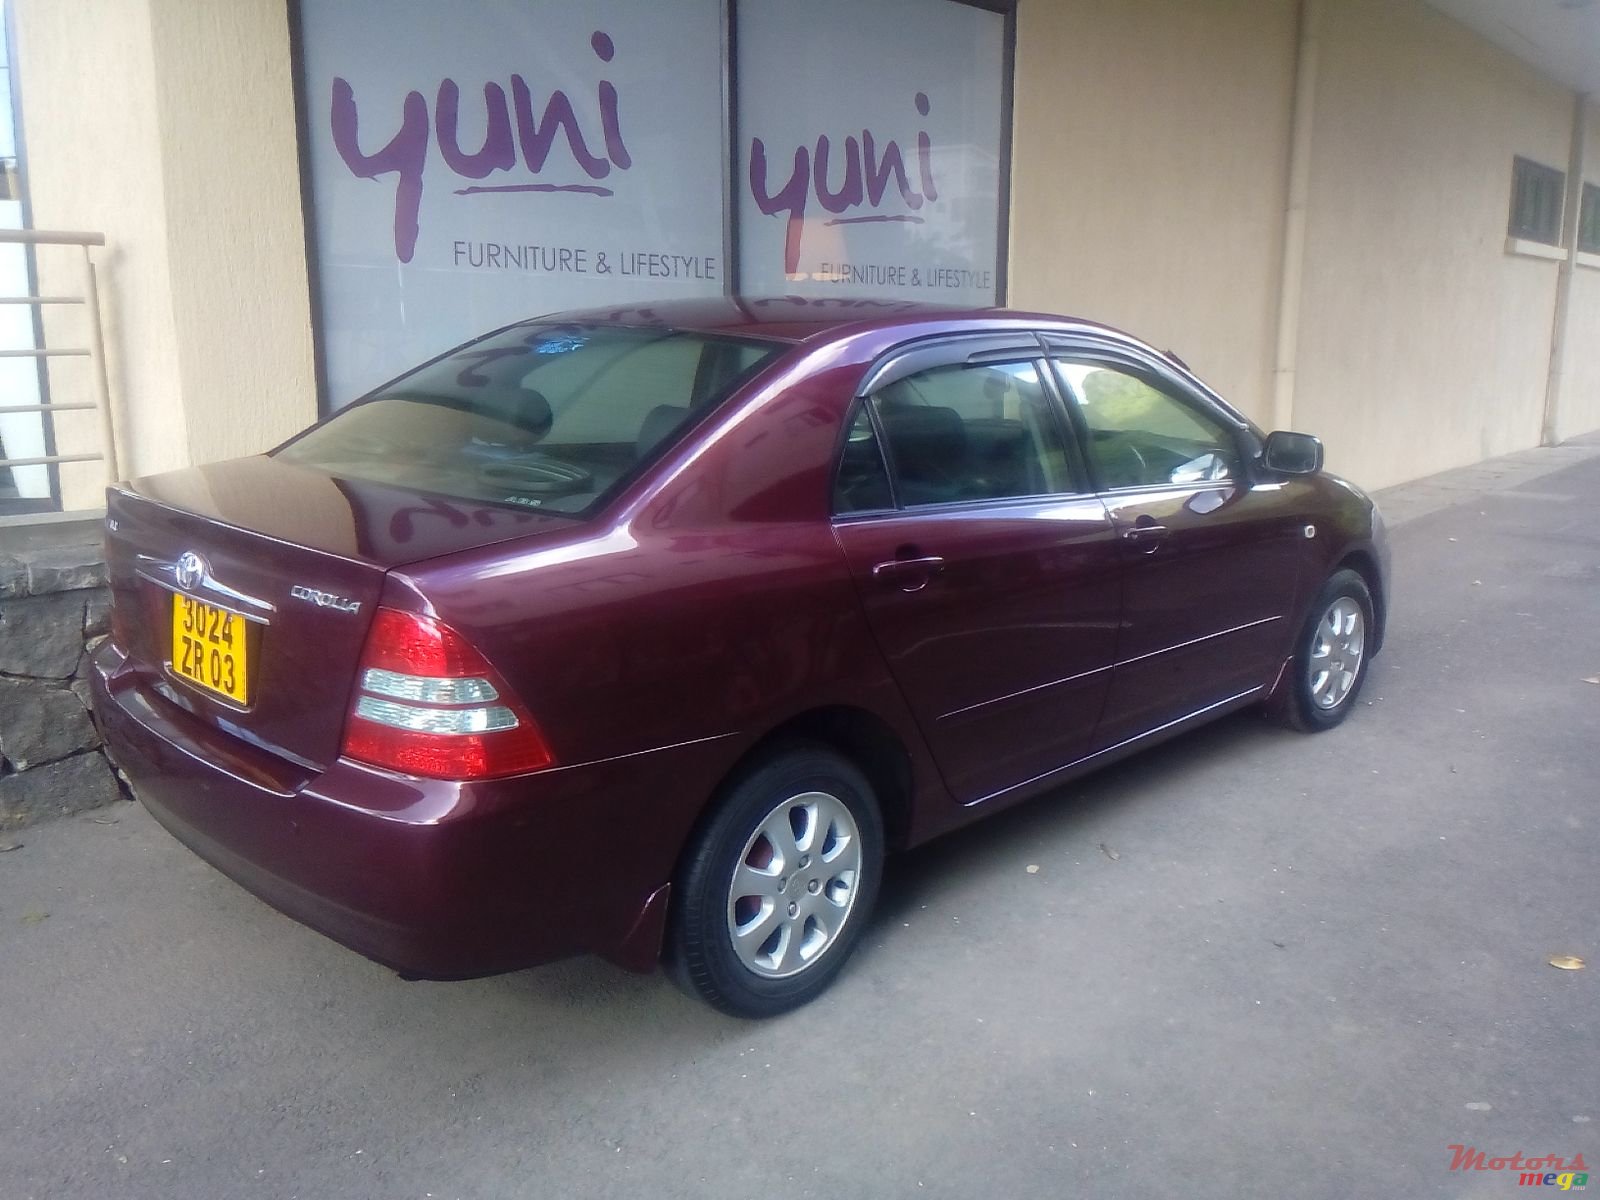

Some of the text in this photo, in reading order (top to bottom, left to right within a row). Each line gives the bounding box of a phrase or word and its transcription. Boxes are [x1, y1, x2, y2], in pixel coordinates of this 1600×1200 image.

[331, 30, 632, 264] yuni
[750, 92, 938, 279] yuni
[454, 241, 716, 280] FURNITURE & LIFESTYLE
[821, 263, 991, 289] FURNITURE & LIFESTYLE
[183, 597, 233, 650] 3024
[290, 585, 362, 615] COROLLA
[181, 635, 235, 694] ZR 03
